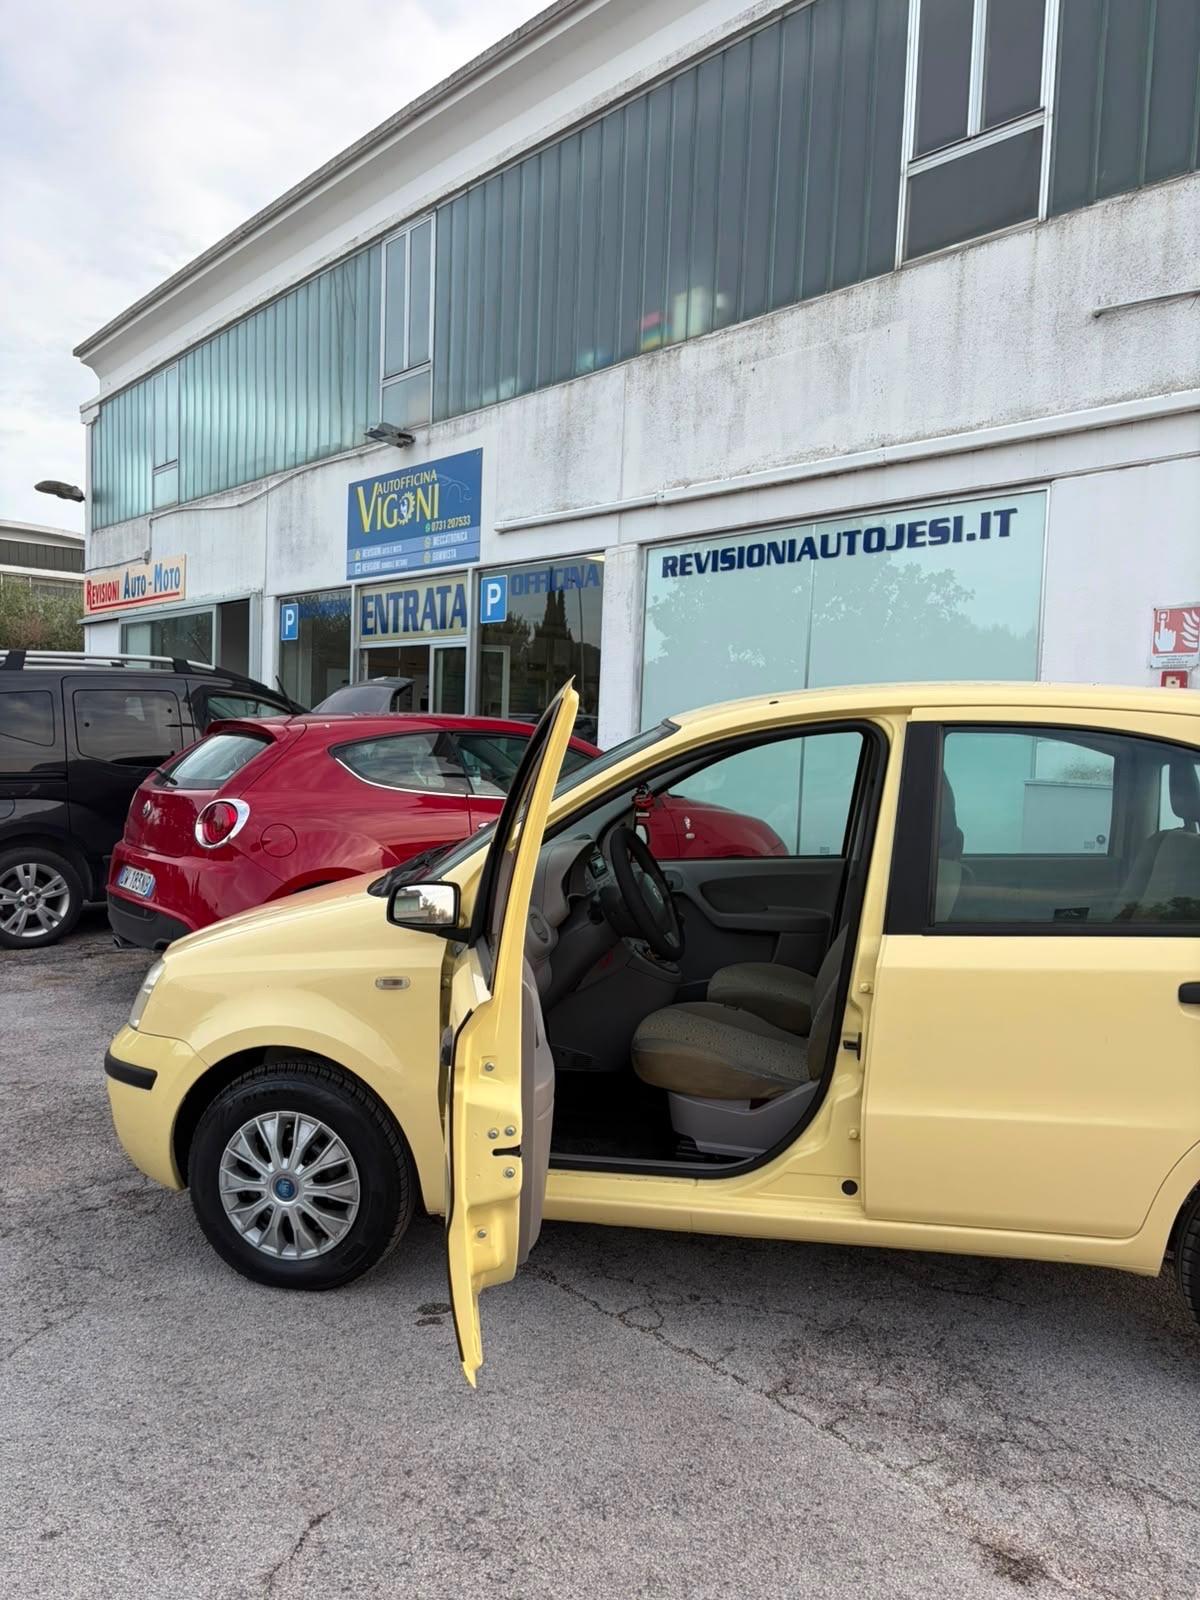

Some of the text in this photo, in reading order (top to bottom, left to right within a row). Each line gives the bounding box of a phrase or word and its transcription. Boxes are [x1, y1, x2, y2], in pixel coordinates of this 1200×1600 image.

[377, 469, 438, 495] AUTOFFICINA
[357, 482, 439, 533] VIGONI
[431, 519, 446, 532] 0731
[662, 508, 1018, 578] REVISIONIAUTOJESI.IT
[87, 580, 120, 605] REVISIONI
[123, 569, 147, 599] AUTO
[154, 563, 181, 593] MOTO
[511, 563, 600, 596] OFFICINA
[361, 584, 468, 636] ENTRATA
[486, 583, 502, 617] P
[286, 610, 295, 635] P
